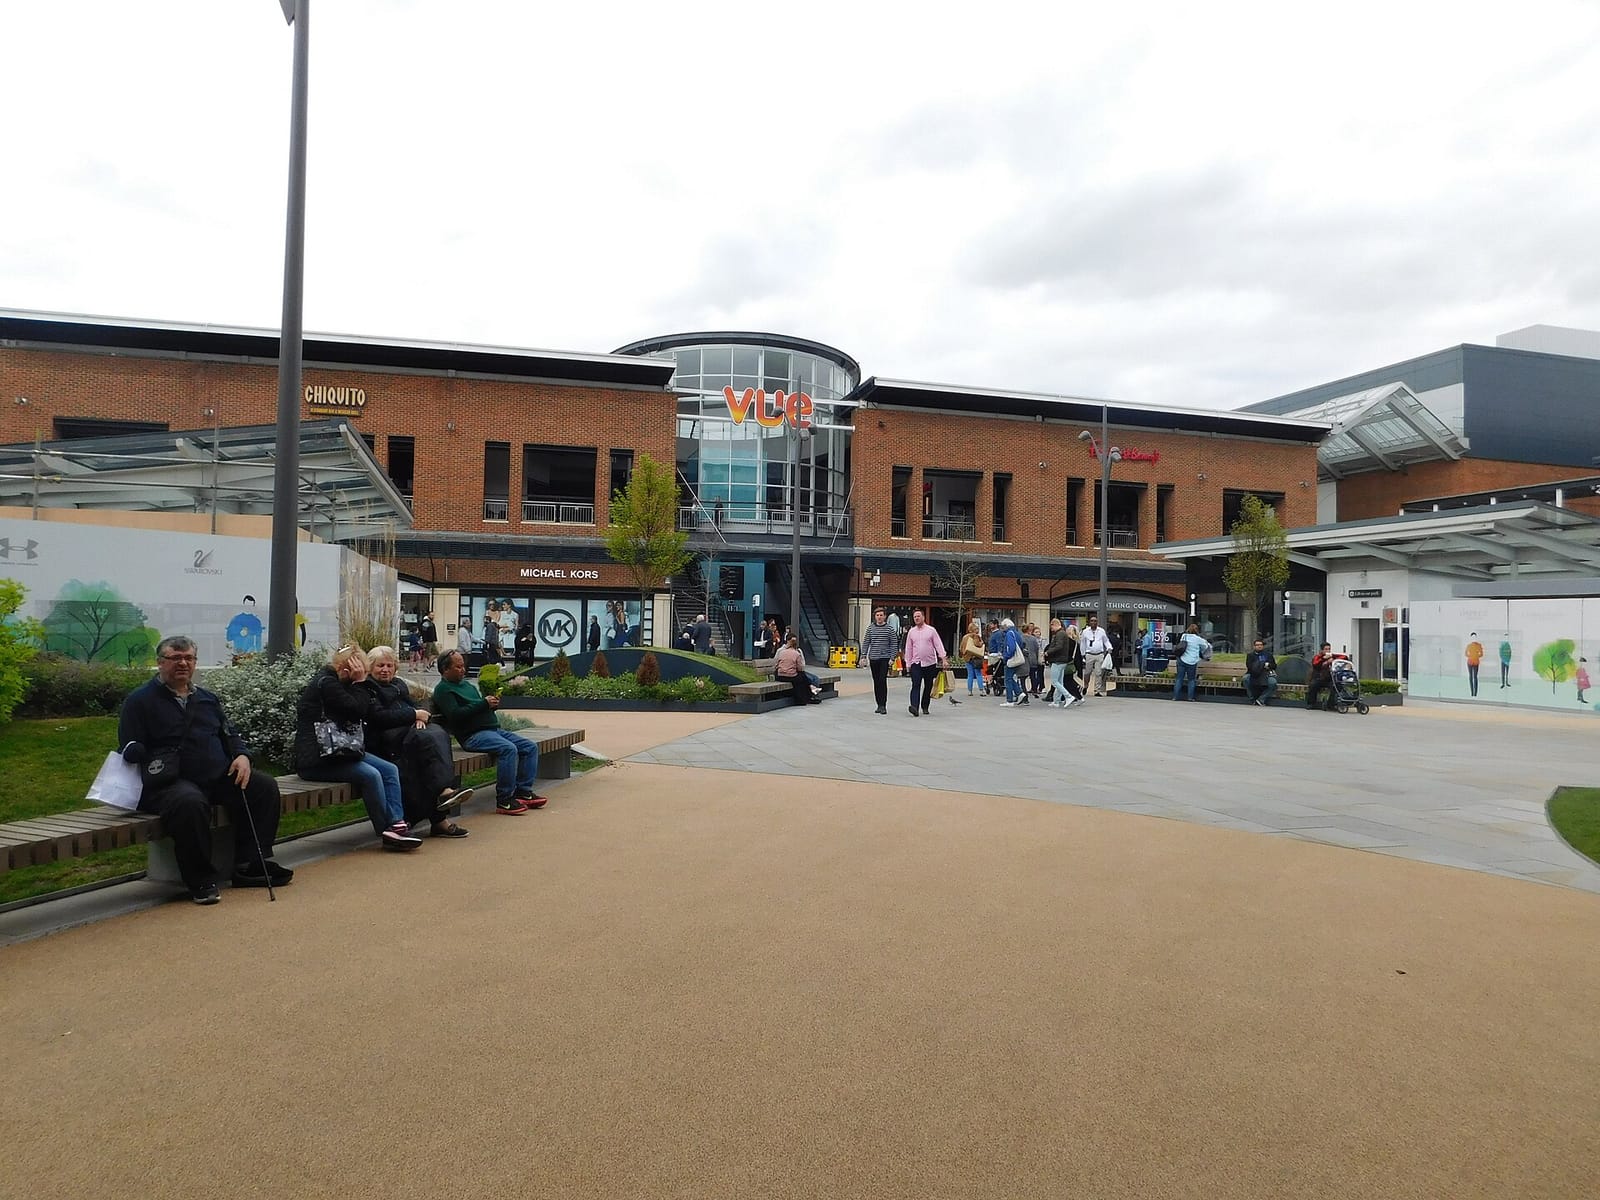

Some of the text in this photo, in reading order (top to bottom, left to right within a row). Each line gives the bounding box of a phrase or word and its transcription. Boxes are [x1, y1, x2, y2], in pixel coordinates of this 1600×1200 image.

[304, 385, 366, 406] CHIQUITO
[520, 568, 599, 579] MICHAEL KORS
[1094, 601, 1131, 609] CTHING
[1133, 602, 1168, 610] COMPANY
[543, 619, 572, 637] MK
[1151, 631, 1170, 642] 15%
